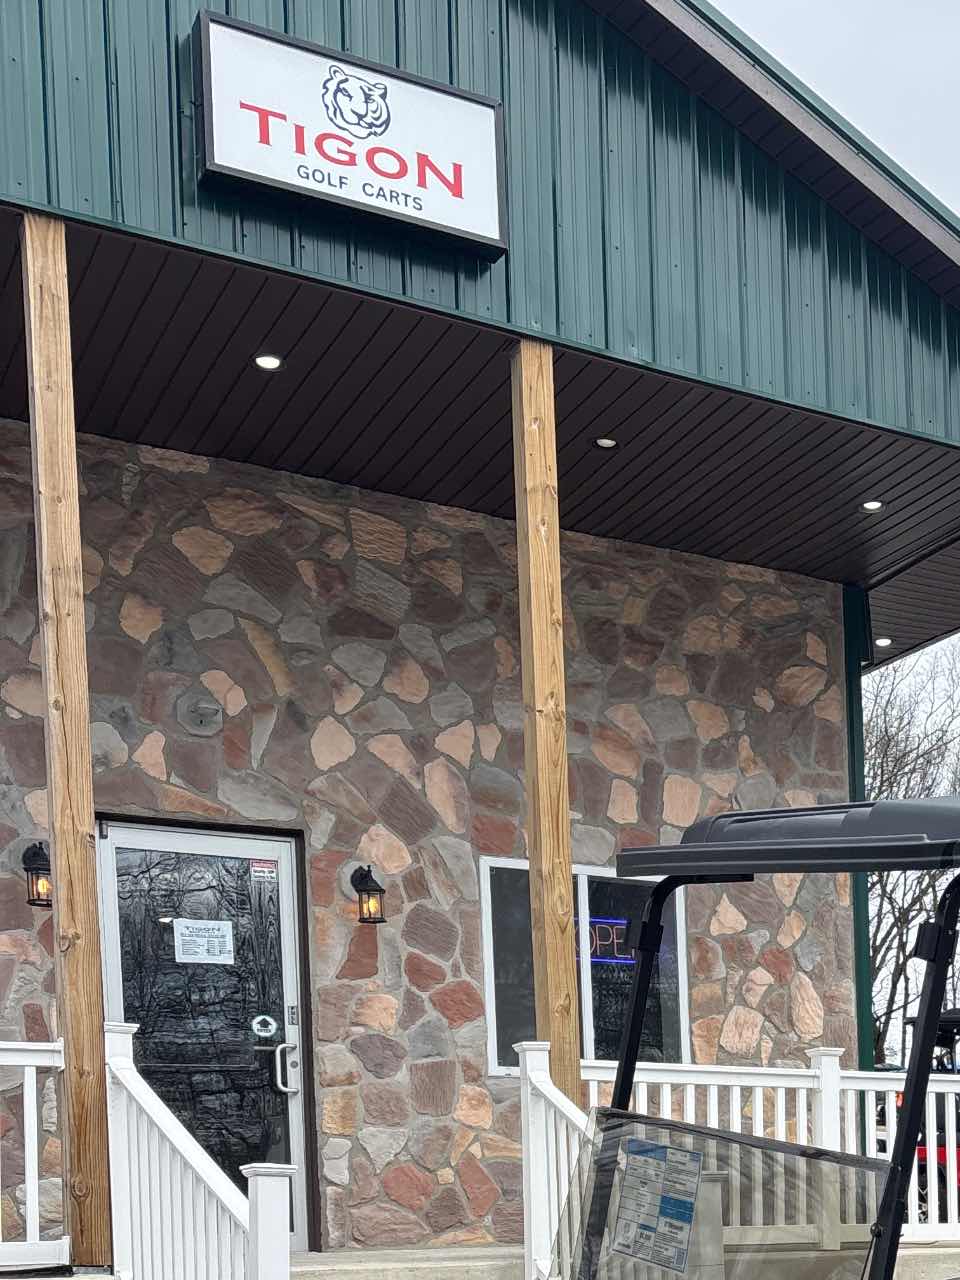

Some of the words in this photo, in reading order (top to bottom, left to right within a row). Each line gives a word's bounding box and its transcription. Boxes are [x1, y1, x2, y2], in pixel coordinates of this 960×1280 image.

[240, 100, 464, 200] TIGON
[296, 164, 349, 190] GOLF
[361, 182, 423, 211] CARTS
